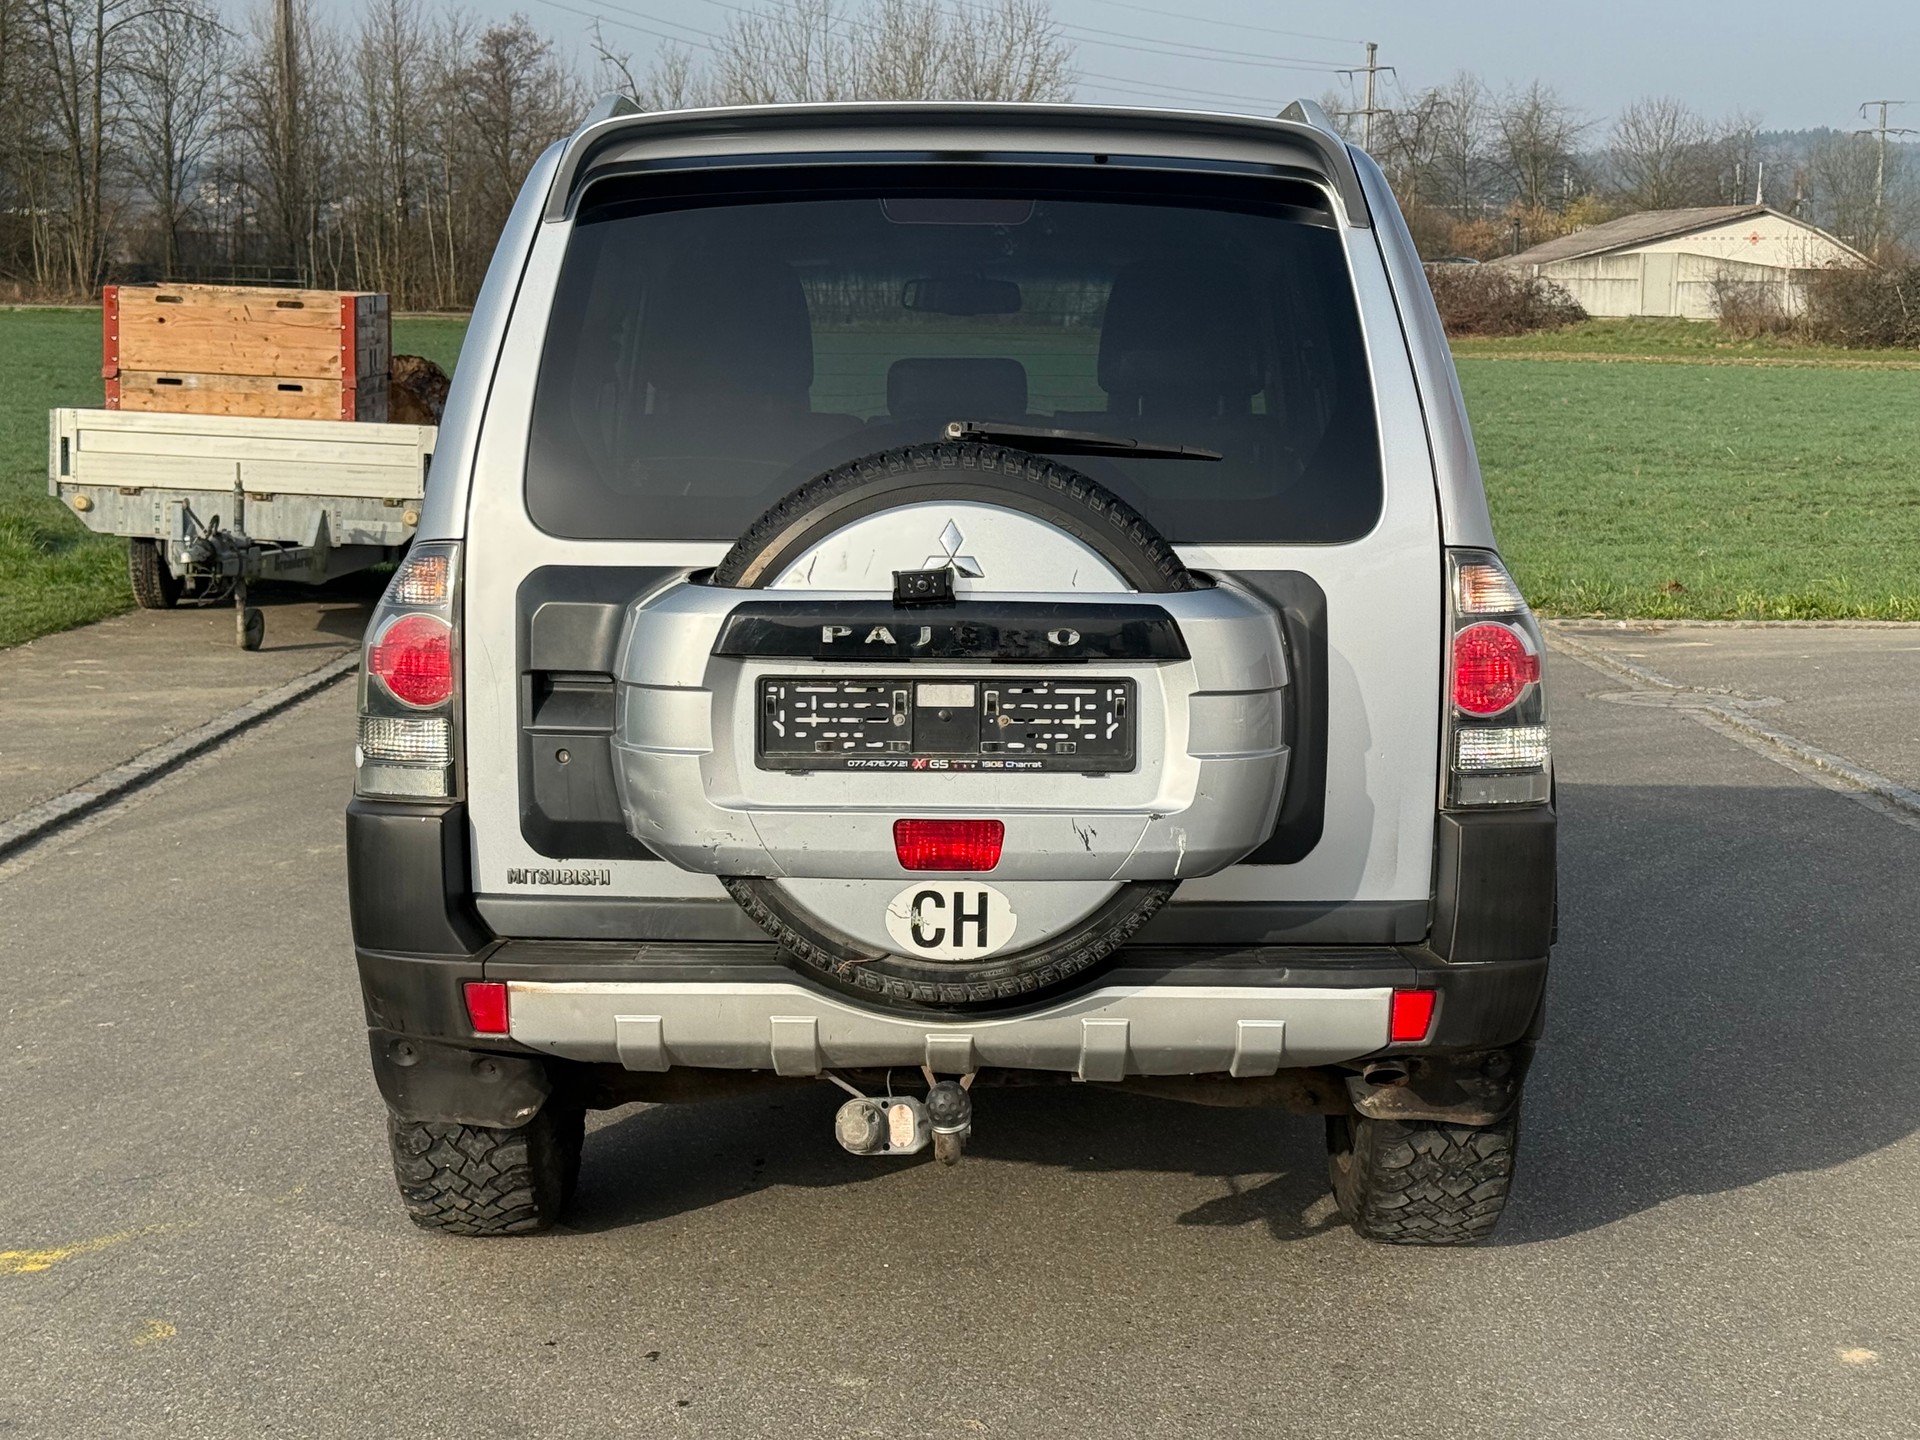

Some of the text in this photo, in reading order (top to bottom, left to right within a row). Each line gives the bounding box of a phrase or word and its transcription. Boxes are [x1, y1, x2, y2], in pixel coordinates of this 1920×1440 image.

[821, 625, 1081, 647] PAJO
[929, 759, 949, 769] GS
[506, 868, 611, 886] MITSUBISHI
[911, 890, 989, 948] CH
